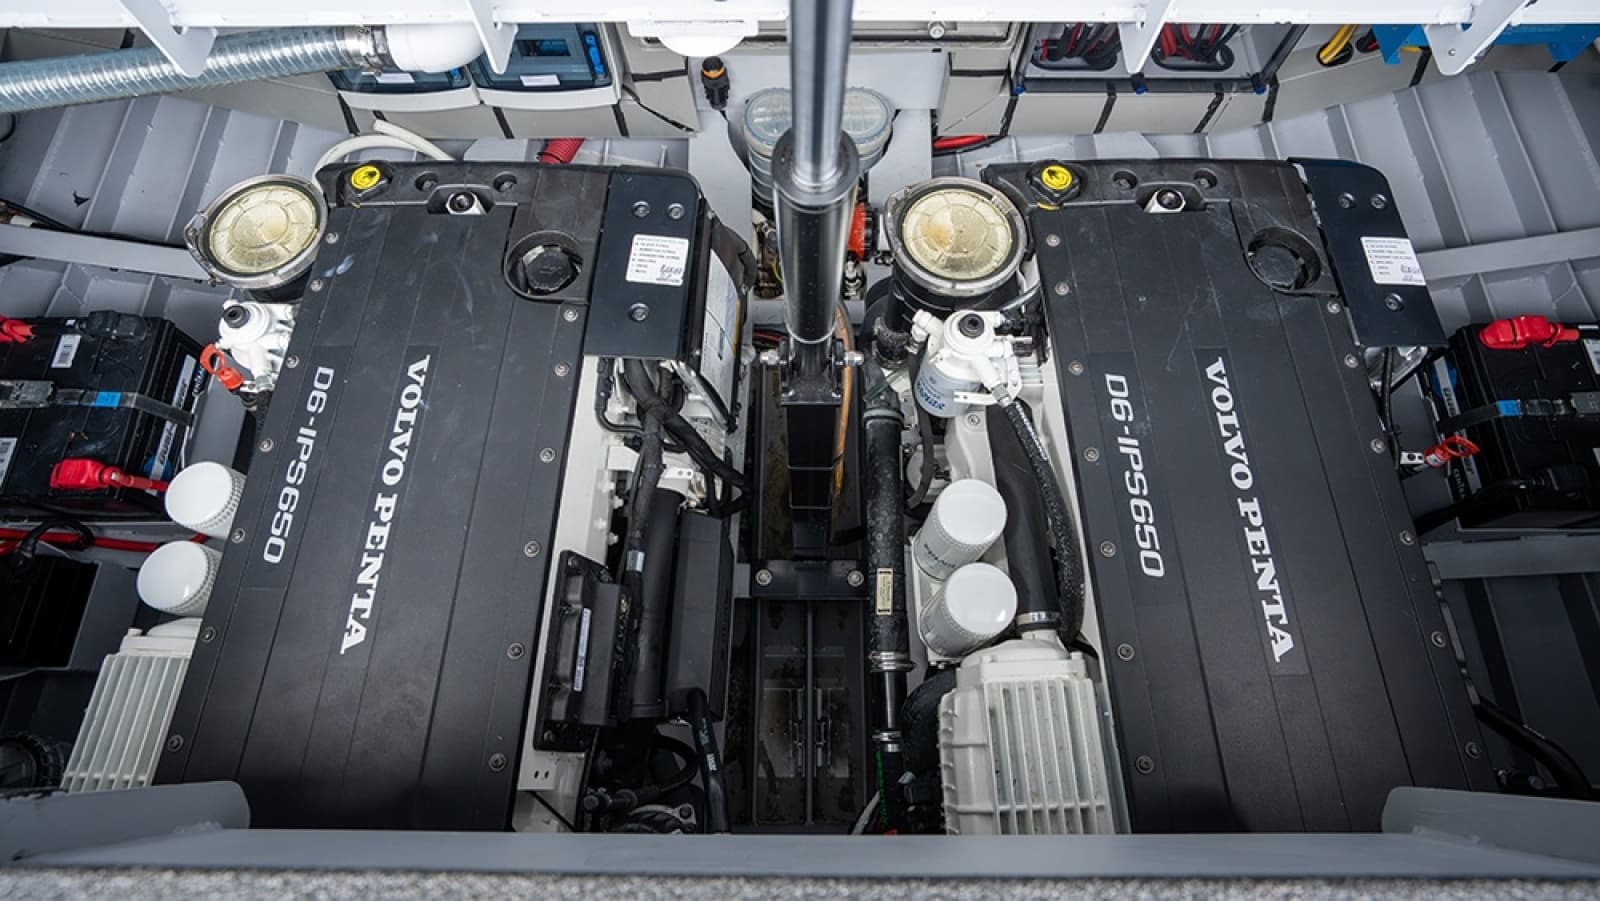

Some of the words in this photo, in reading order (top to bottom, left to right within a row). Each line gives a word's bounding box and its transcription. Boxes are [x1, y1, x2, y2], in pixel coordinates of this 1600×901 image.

[264, 367, 335, 564] D6-IPS650
[382, 355, 431, 486] VOLVO
[1105, 374, 1165, 577] D6-IPS650
[1206, 357, 1253, 490] VOLVO
[1238, 498, 1294, 663] PENTA
[340, 493, 399, 655] PENTA
